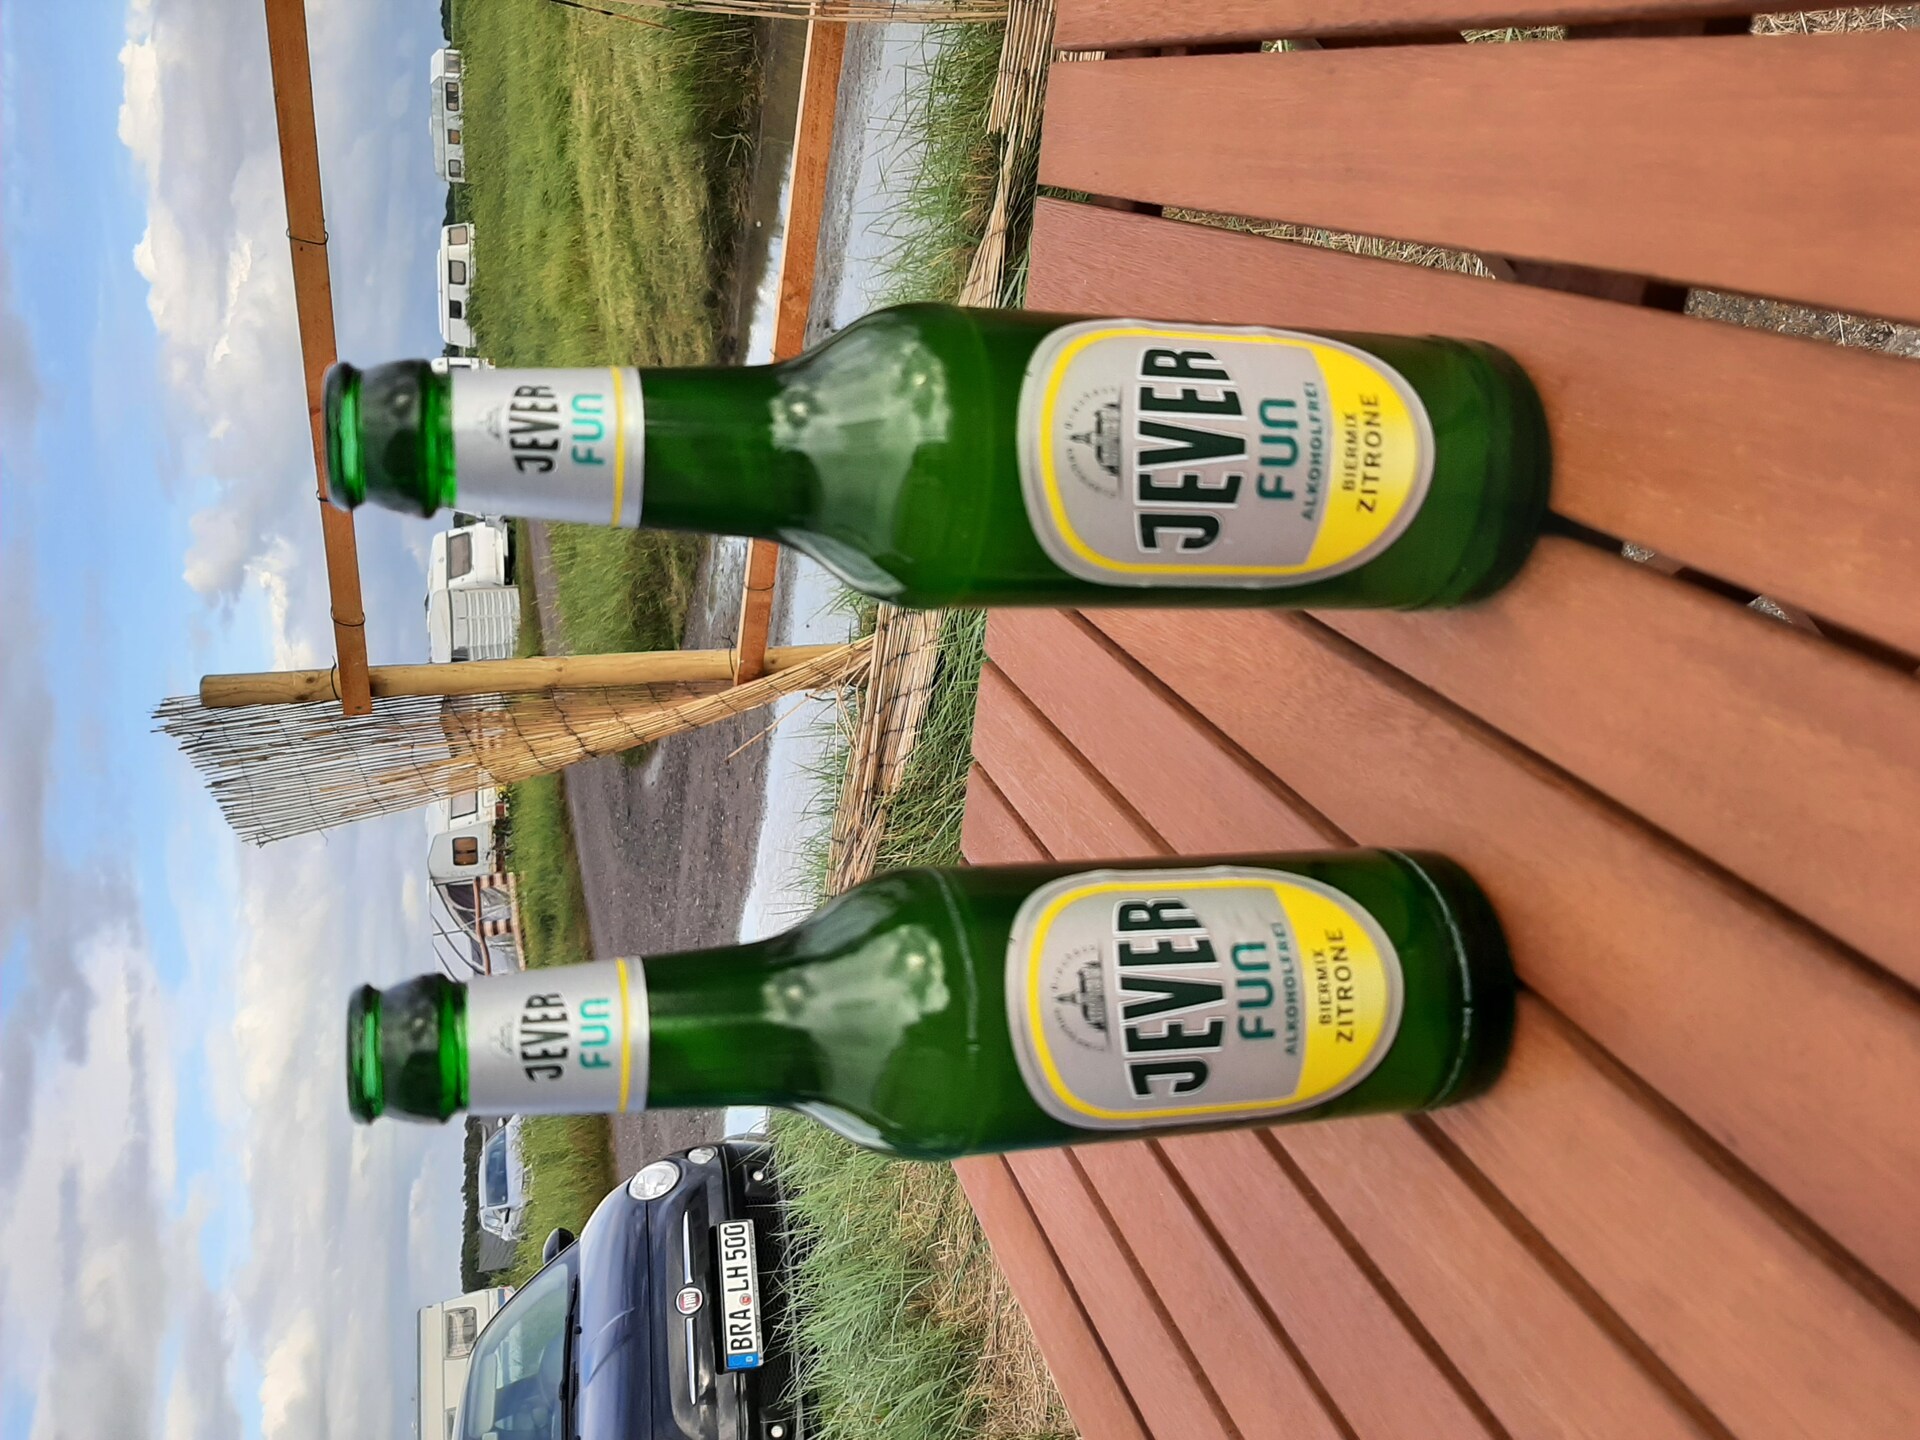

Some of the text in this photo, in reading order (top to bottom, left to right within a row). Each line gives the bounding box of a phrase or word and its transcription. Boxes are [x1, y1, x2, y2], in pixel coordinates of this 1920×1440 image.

[509, 386, 559, 472] JEVER
[571, 395, 605, 466] FUN
[1136, 348, 1247, 552] JEVER
[1256, 398, 1298, 501] FUN
[1301, 382, 1323, 521] ALKOHOLFREI
[1341, 413, 1358, 491] BIERMIX
[1357, 394, 1382, 513] ZITRONE
[1115, 899, 1226, 1097] JEVER
[1230, 941, 1275, 1040] FUN
[1272, 922, 1299, 1056] ALKOHOLFREI
[1312, 949, 1332, 1025] BIERMIX
[1325, 929, 1354, 1043] ZITRONE
[521, 993, 569, 1082] JEVER
[579, 999, 611, 1069] FUN
[724, 1225, 747, 1260] 500
[726, 1266, 749, 1292] LH
[729, 1308, 753, 1350] BRA
